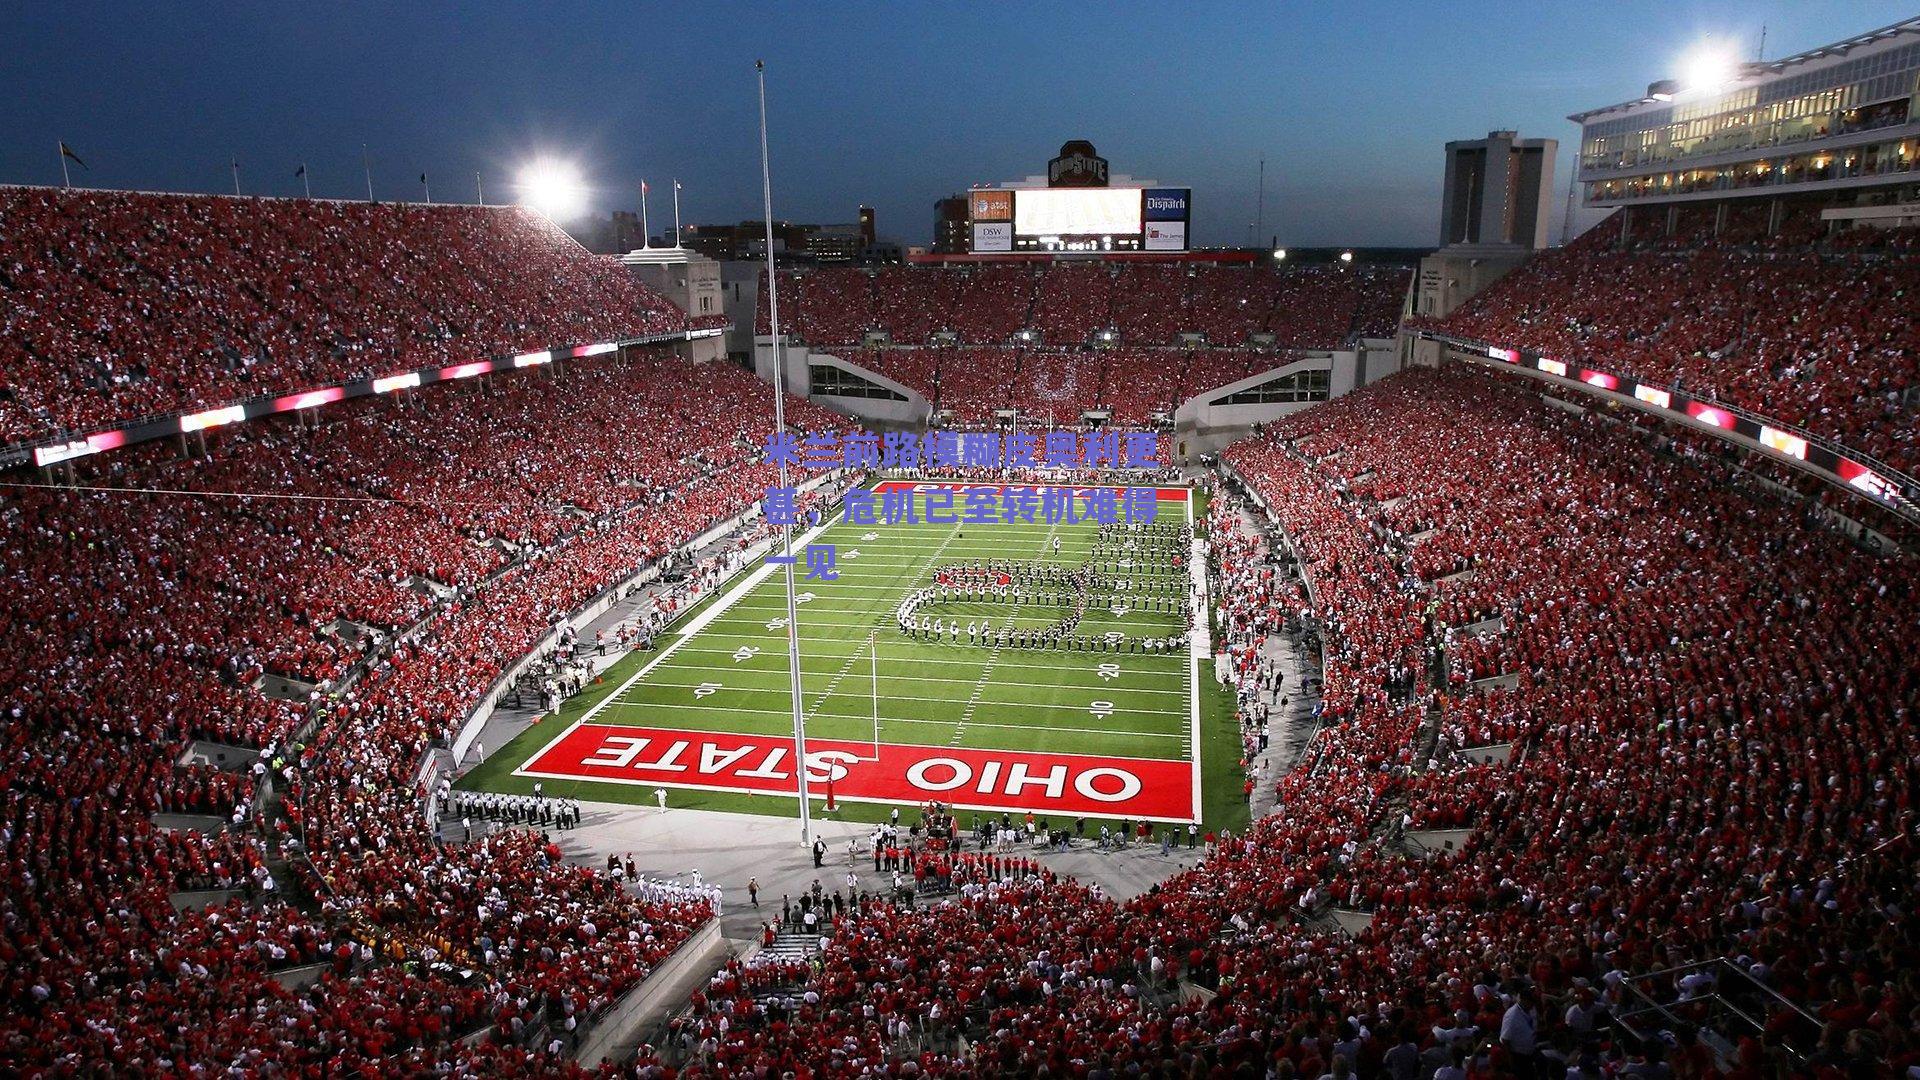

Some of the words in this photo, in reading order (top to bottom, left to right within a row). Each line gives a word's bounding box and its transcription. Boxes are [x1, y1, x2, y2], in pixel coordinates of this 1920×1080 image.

[1147, 197, 1185, 211] Dispatch
[983, 228, 1002, 236] DSW
[1097, 664, 1120, 678] 20
[1089, 700, 1114, 715] 10
[580, 736, 860, 783] STATE
[905, 757, 1142, 803] OHIO
